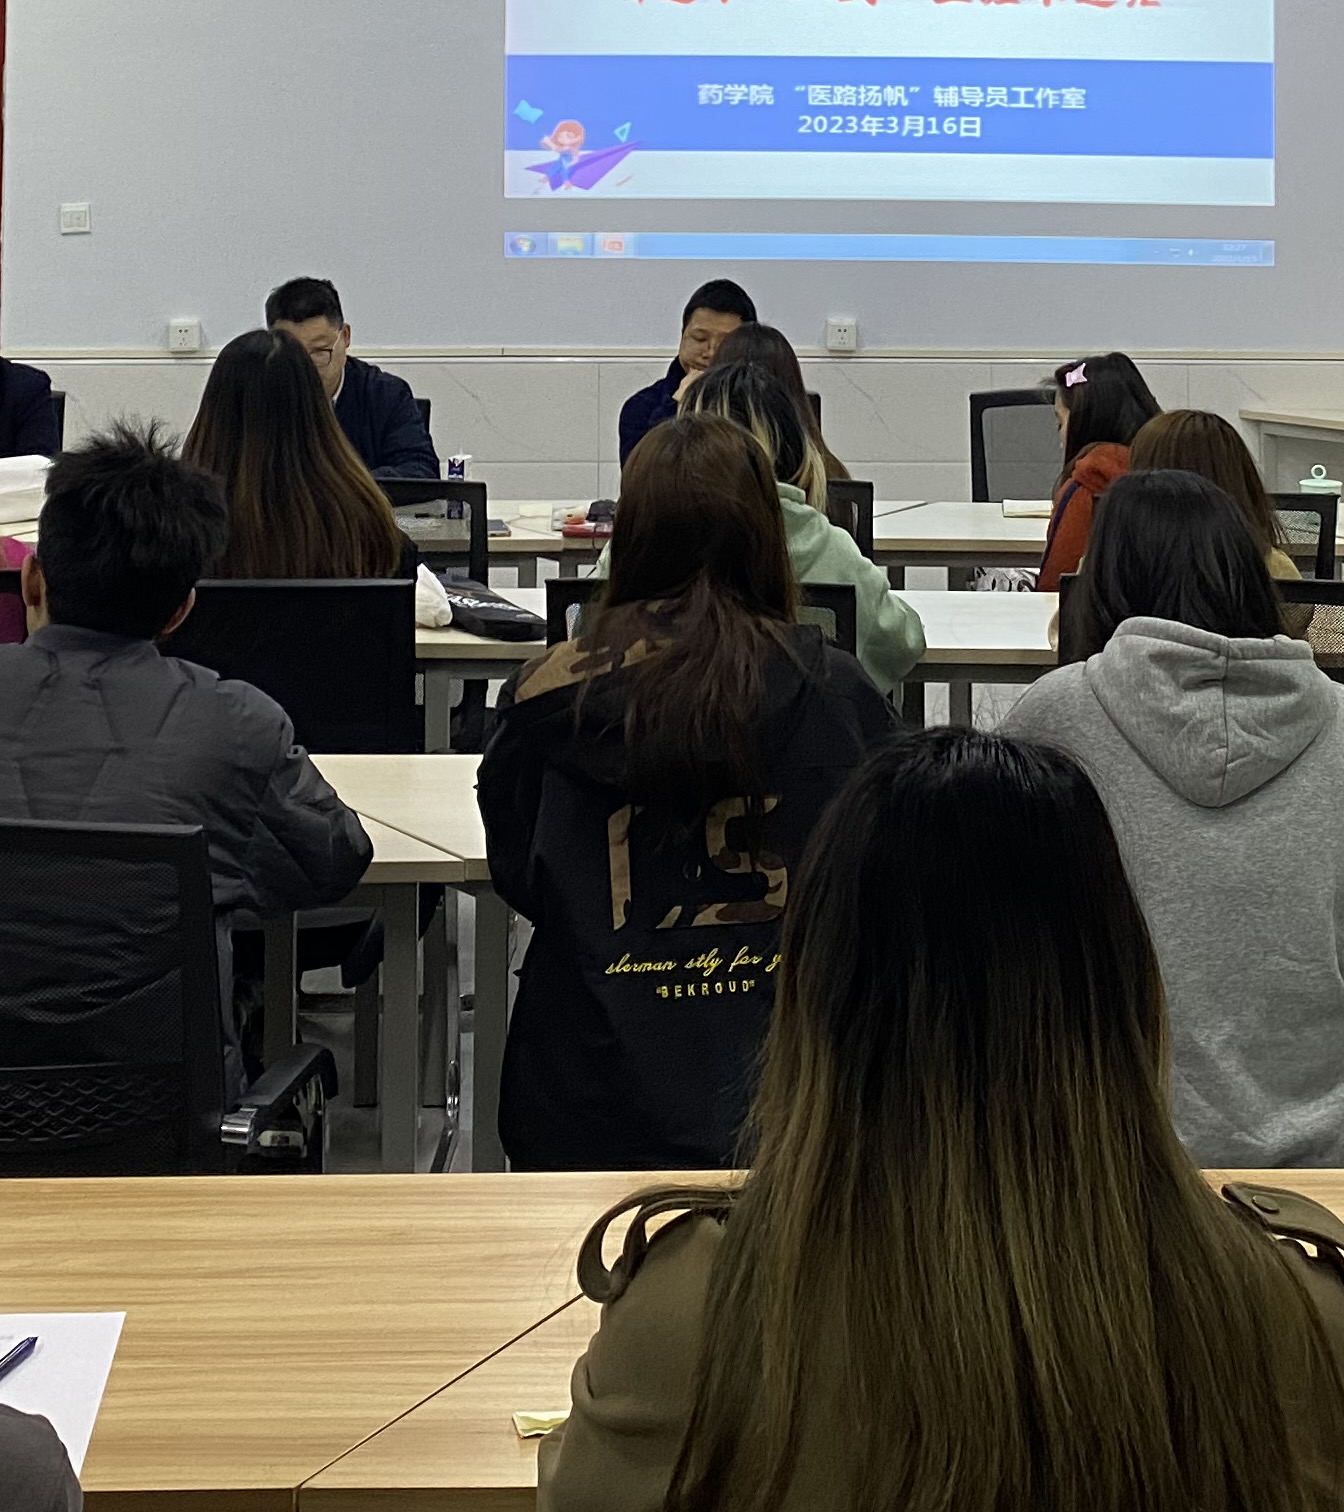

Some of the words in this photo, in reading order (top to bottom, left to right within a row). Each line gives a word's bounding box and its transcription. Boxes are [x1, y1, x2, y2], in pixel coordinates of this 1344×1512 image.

[697, 84, 775, 106] 药学院
[798, 115, 982, 138] 2023年3月16日
